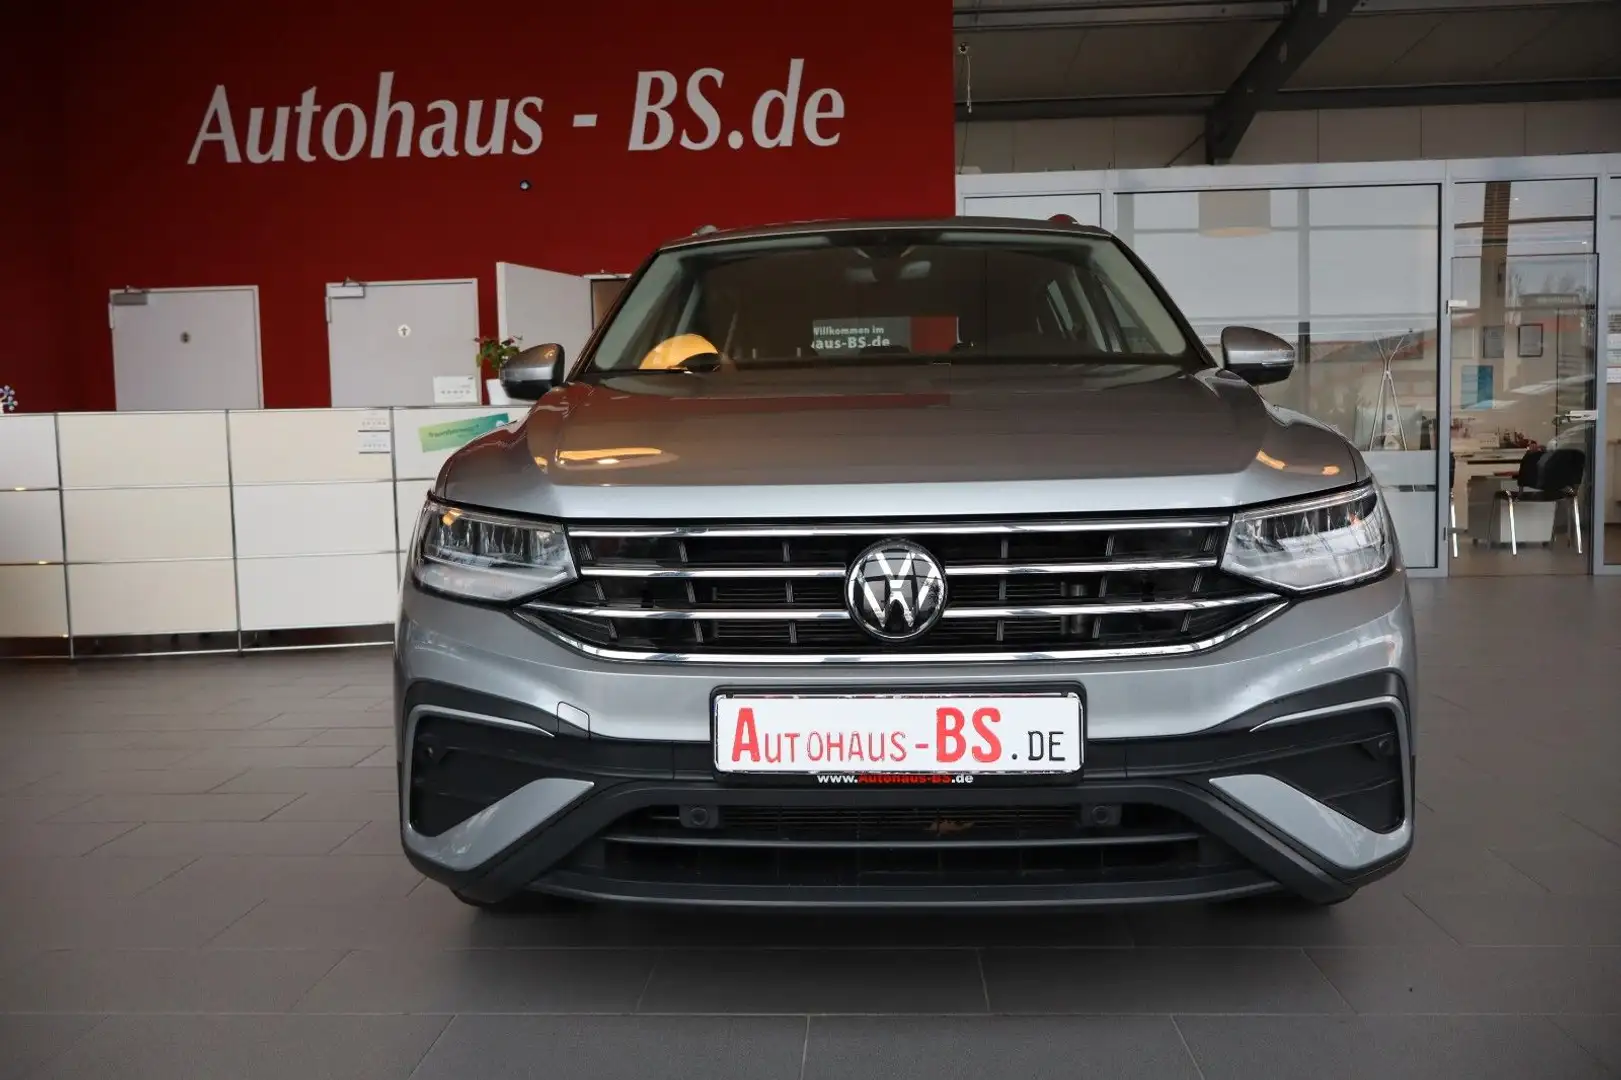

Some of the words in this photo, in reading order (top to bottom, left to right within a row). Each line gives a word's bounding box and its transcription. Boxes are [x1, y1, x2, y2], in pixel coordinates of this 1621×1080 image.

[187, 71, 544, 164] Autohaus
[628, 58, 845, 151] BS.de
[872, 325, 884, 334] im
[811, 336, 890, 349] aus-BS.de
